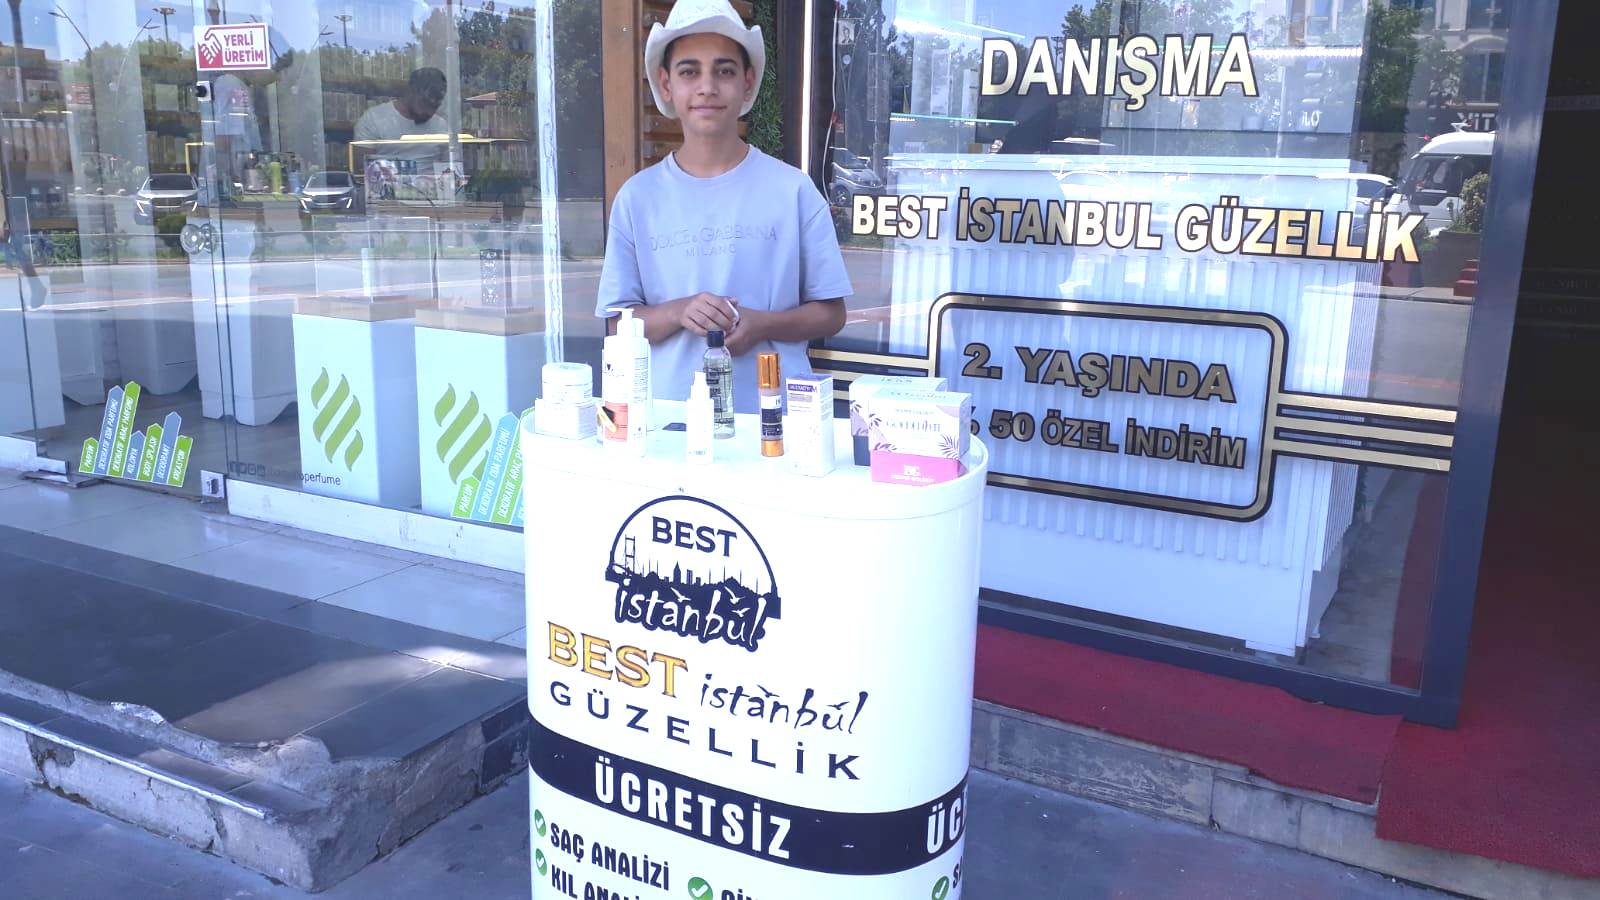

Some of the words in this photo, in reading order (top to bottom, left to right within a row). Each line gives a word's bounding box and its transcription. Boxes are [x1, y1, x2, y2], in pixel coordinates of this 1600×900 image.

[223, 30, 254, 47] YERLİ
[224, 47, 264, 63] ÜRETİM
[981, 33, 1259, 111] DANIŞMA
[852, 194, 948, 240] BEST
[956, 187, 1163, 249] İSTANBUL
[1175, 195, 1428, 264] GÜZELLİK
[962, 342, 1003, 380] 2.
[1014, 346, 1237, 403] YAŞINDA
[989, 409, 1036, 442] 50
[1041, 409, 1119, 453] ÖZEL
[1124, 418, 1248, 469] İNDİRİM
[652, 516, 737, 557] BEST
[618, 578, 767, 648] istanbul
[547, 621, 689, 698] BEST
[700, 673, 869, 734] istanbul
[550, 681, 860, 781] GÜZELLİK
[595, 756, 791, 860] ÜCRETSİZ
[550, 822, 585, 863] SAÇ
[591, 841, 670, 891] ANALİZİ
[551, 864, 578, 900] KIL
